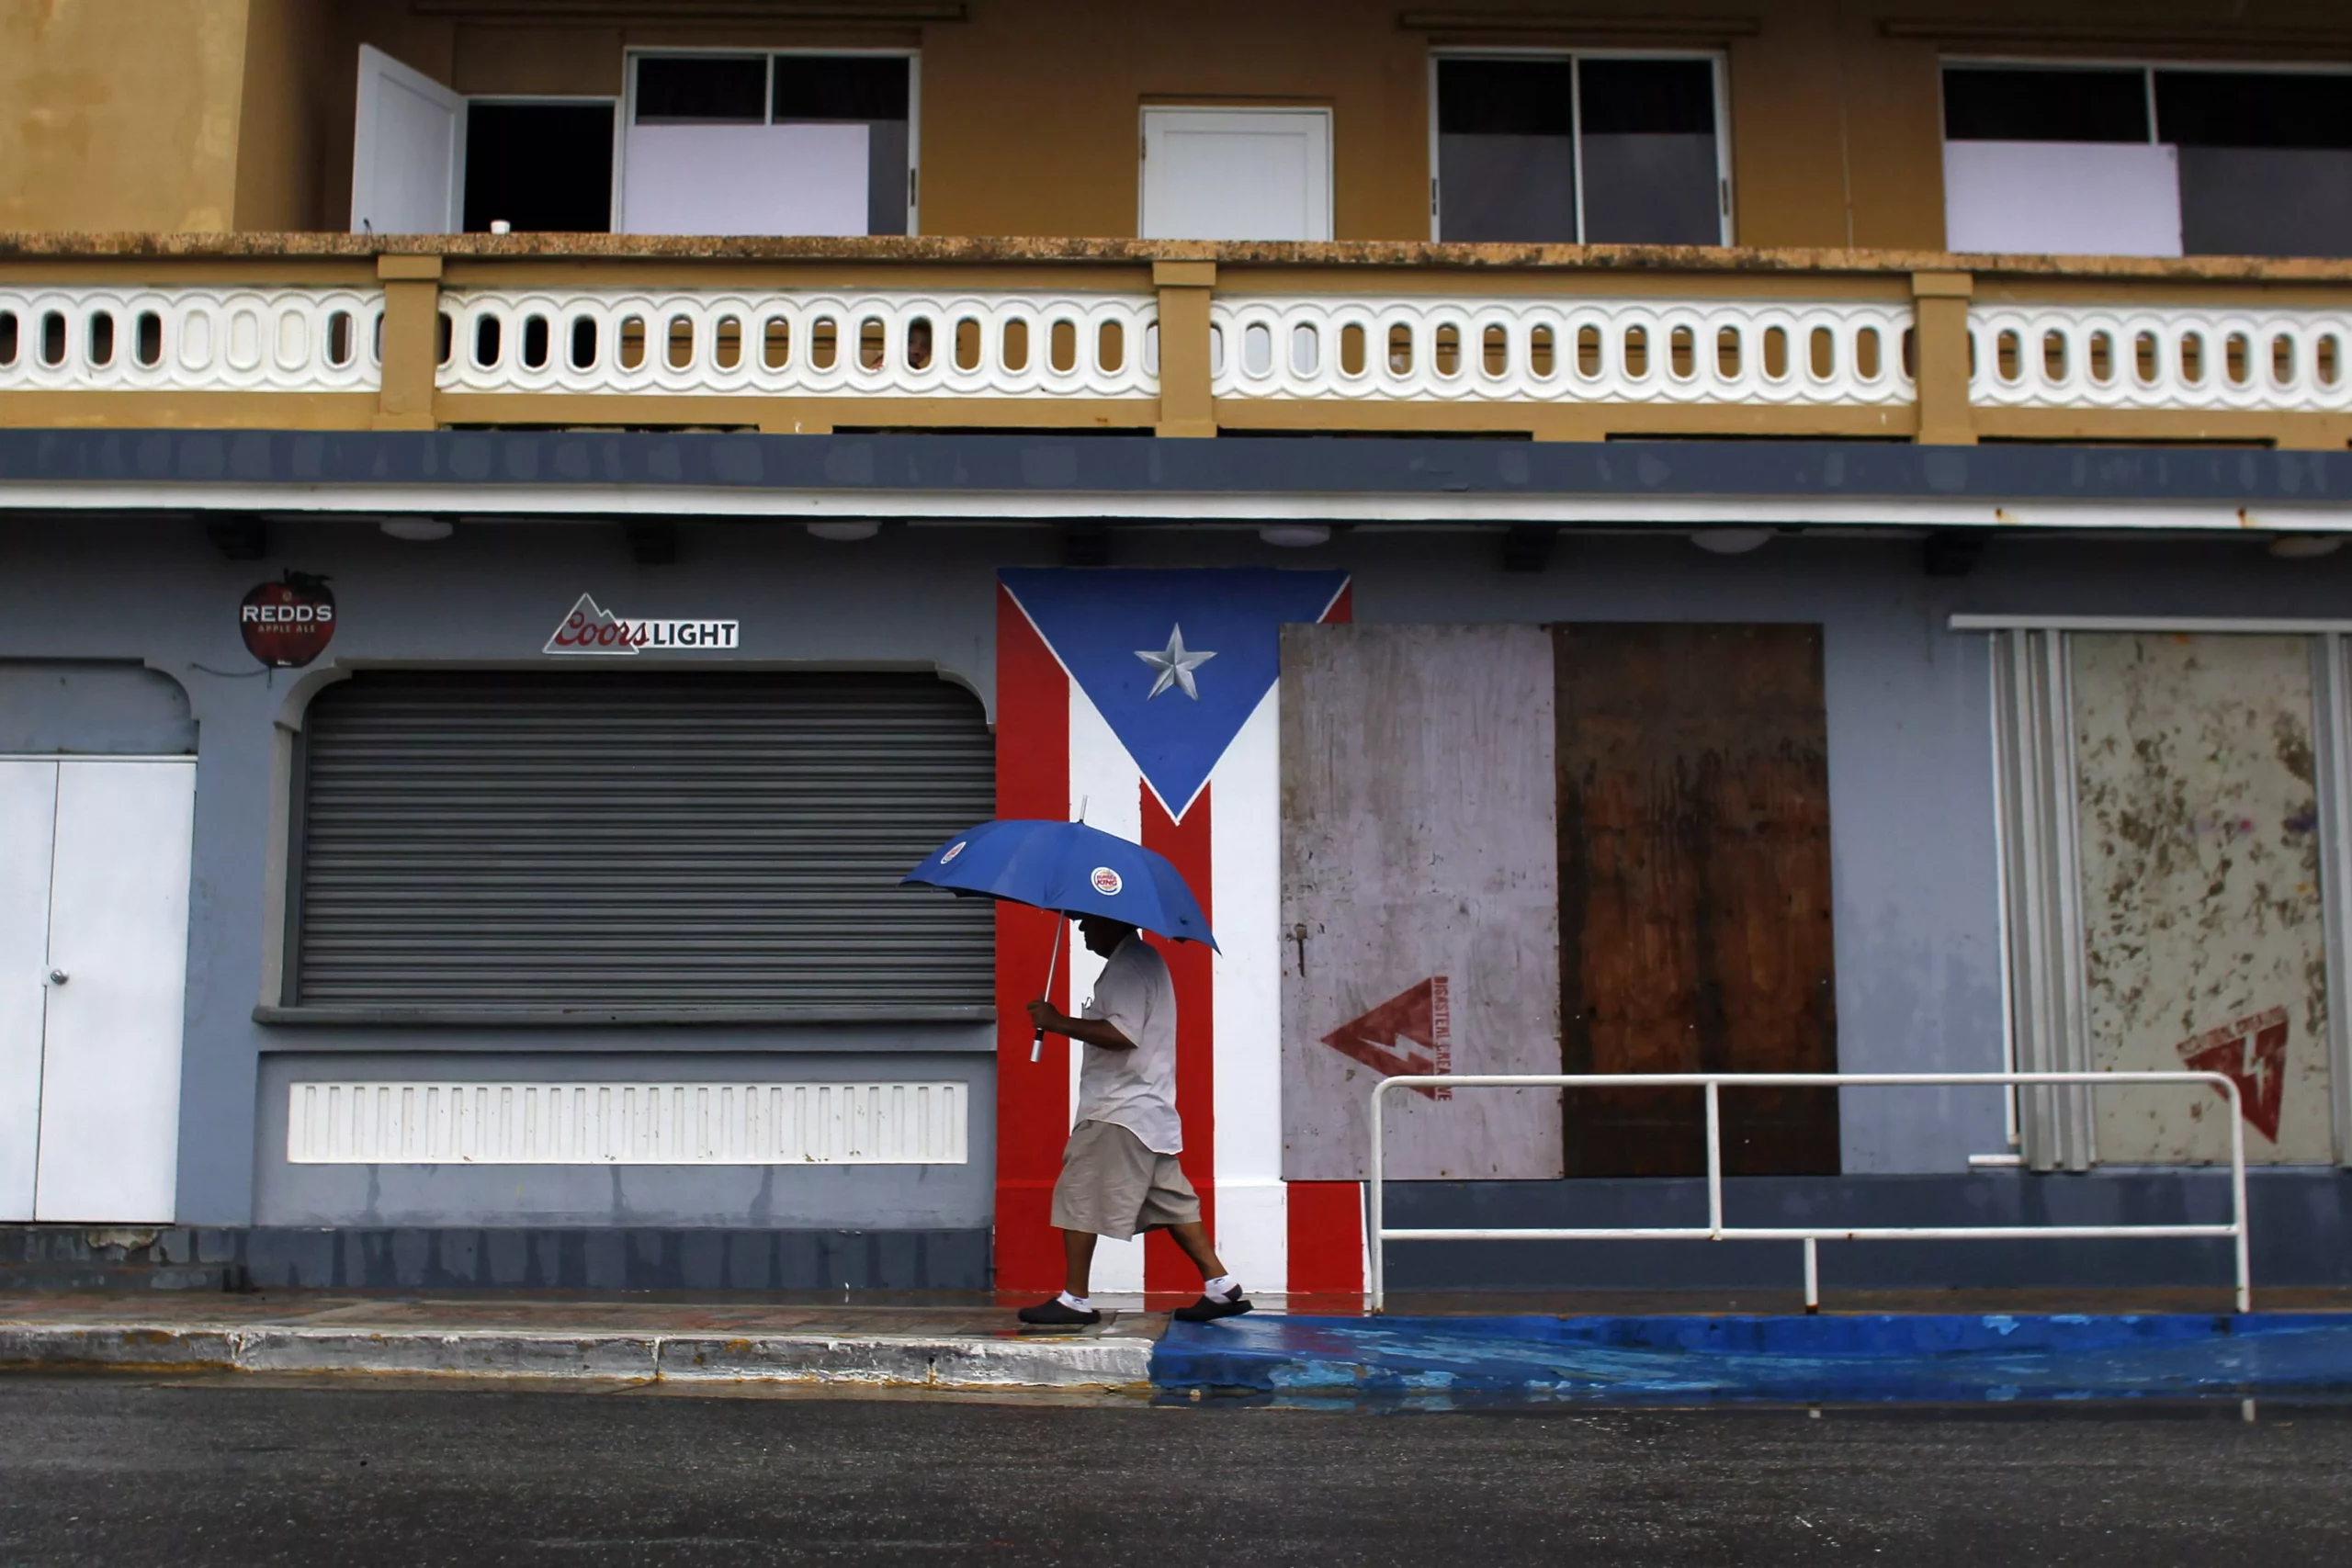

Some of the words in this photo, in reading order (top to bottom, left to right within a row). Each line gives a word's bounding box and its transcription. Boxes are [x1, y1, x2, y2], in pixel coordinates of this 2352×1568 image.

[258, 624, 291, 634] APPLE
[296, 624, 316, 634] ALE
[555, 611, 650, 647] Coors
[653, 623, 736, 645] LIGHT
